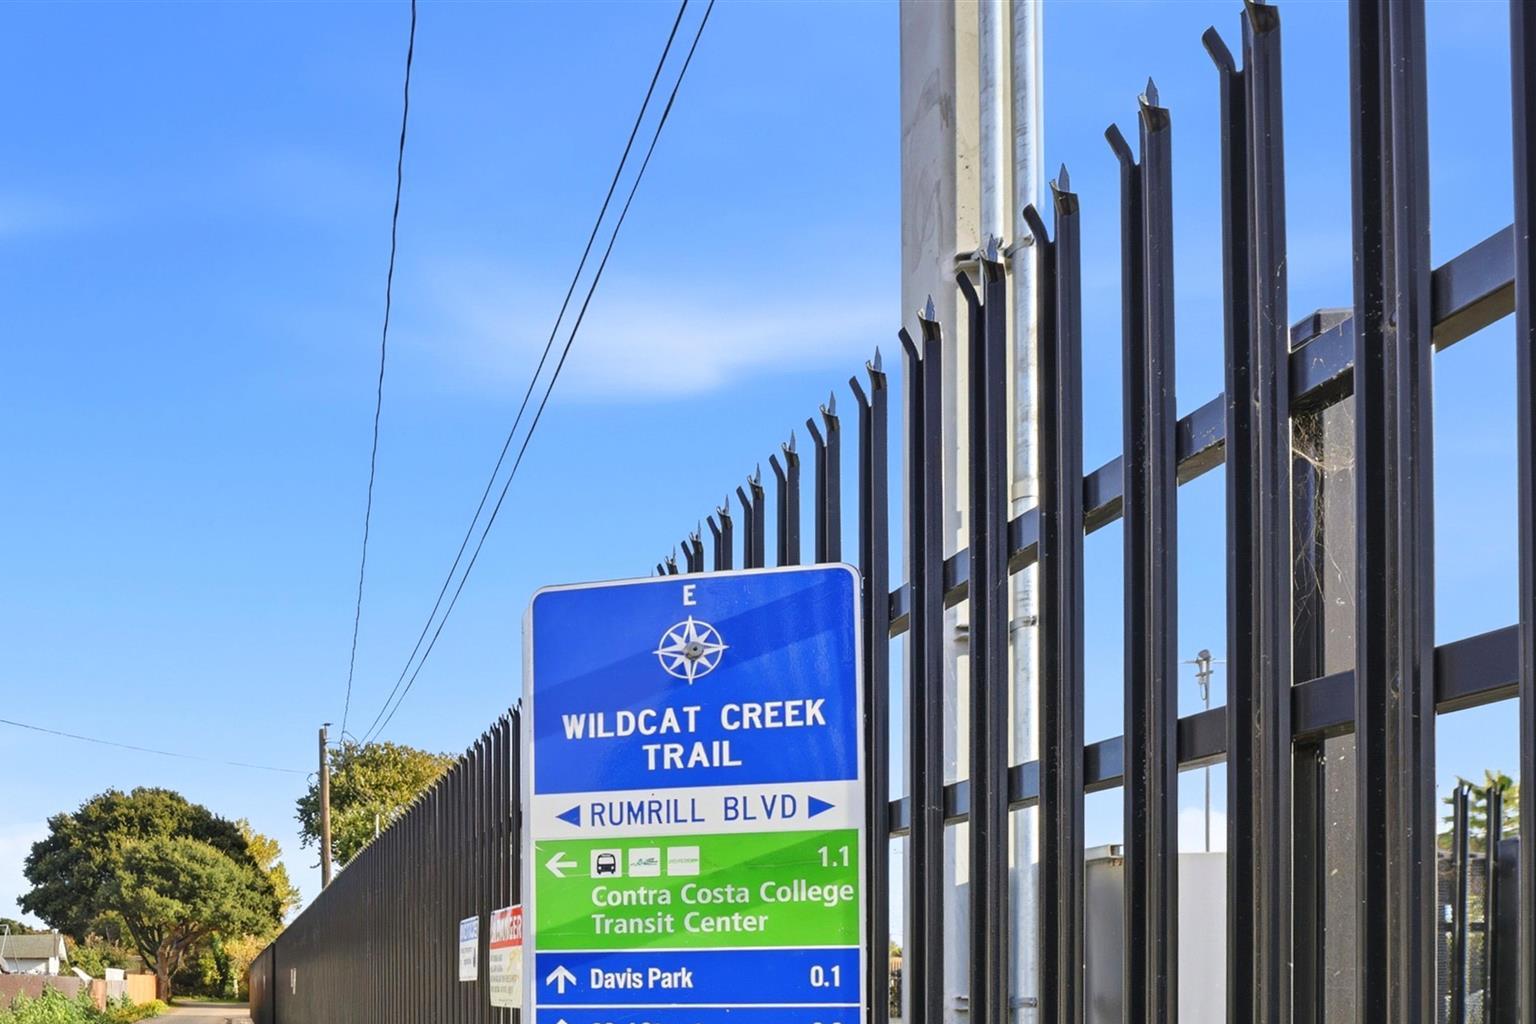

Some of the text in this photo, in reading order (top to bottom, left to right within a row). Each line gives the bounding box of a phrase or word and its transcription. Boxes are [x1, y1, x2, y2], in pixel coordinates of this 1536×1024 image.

[683, 585, 697, 606] E
[561, 698, 826, 740] WILDCAT CREEK
[642, 741, 742, 770] TRAIL
[590, 794, 797, 827] RUMRILL BLVD
[817, 845, 849, 867] 1.1
[591, 878, 854, 907] Contra Costa College
[591, 911, 768, 935] Transit Center
[590, 965, 841, 990] Davis Park 0.1
